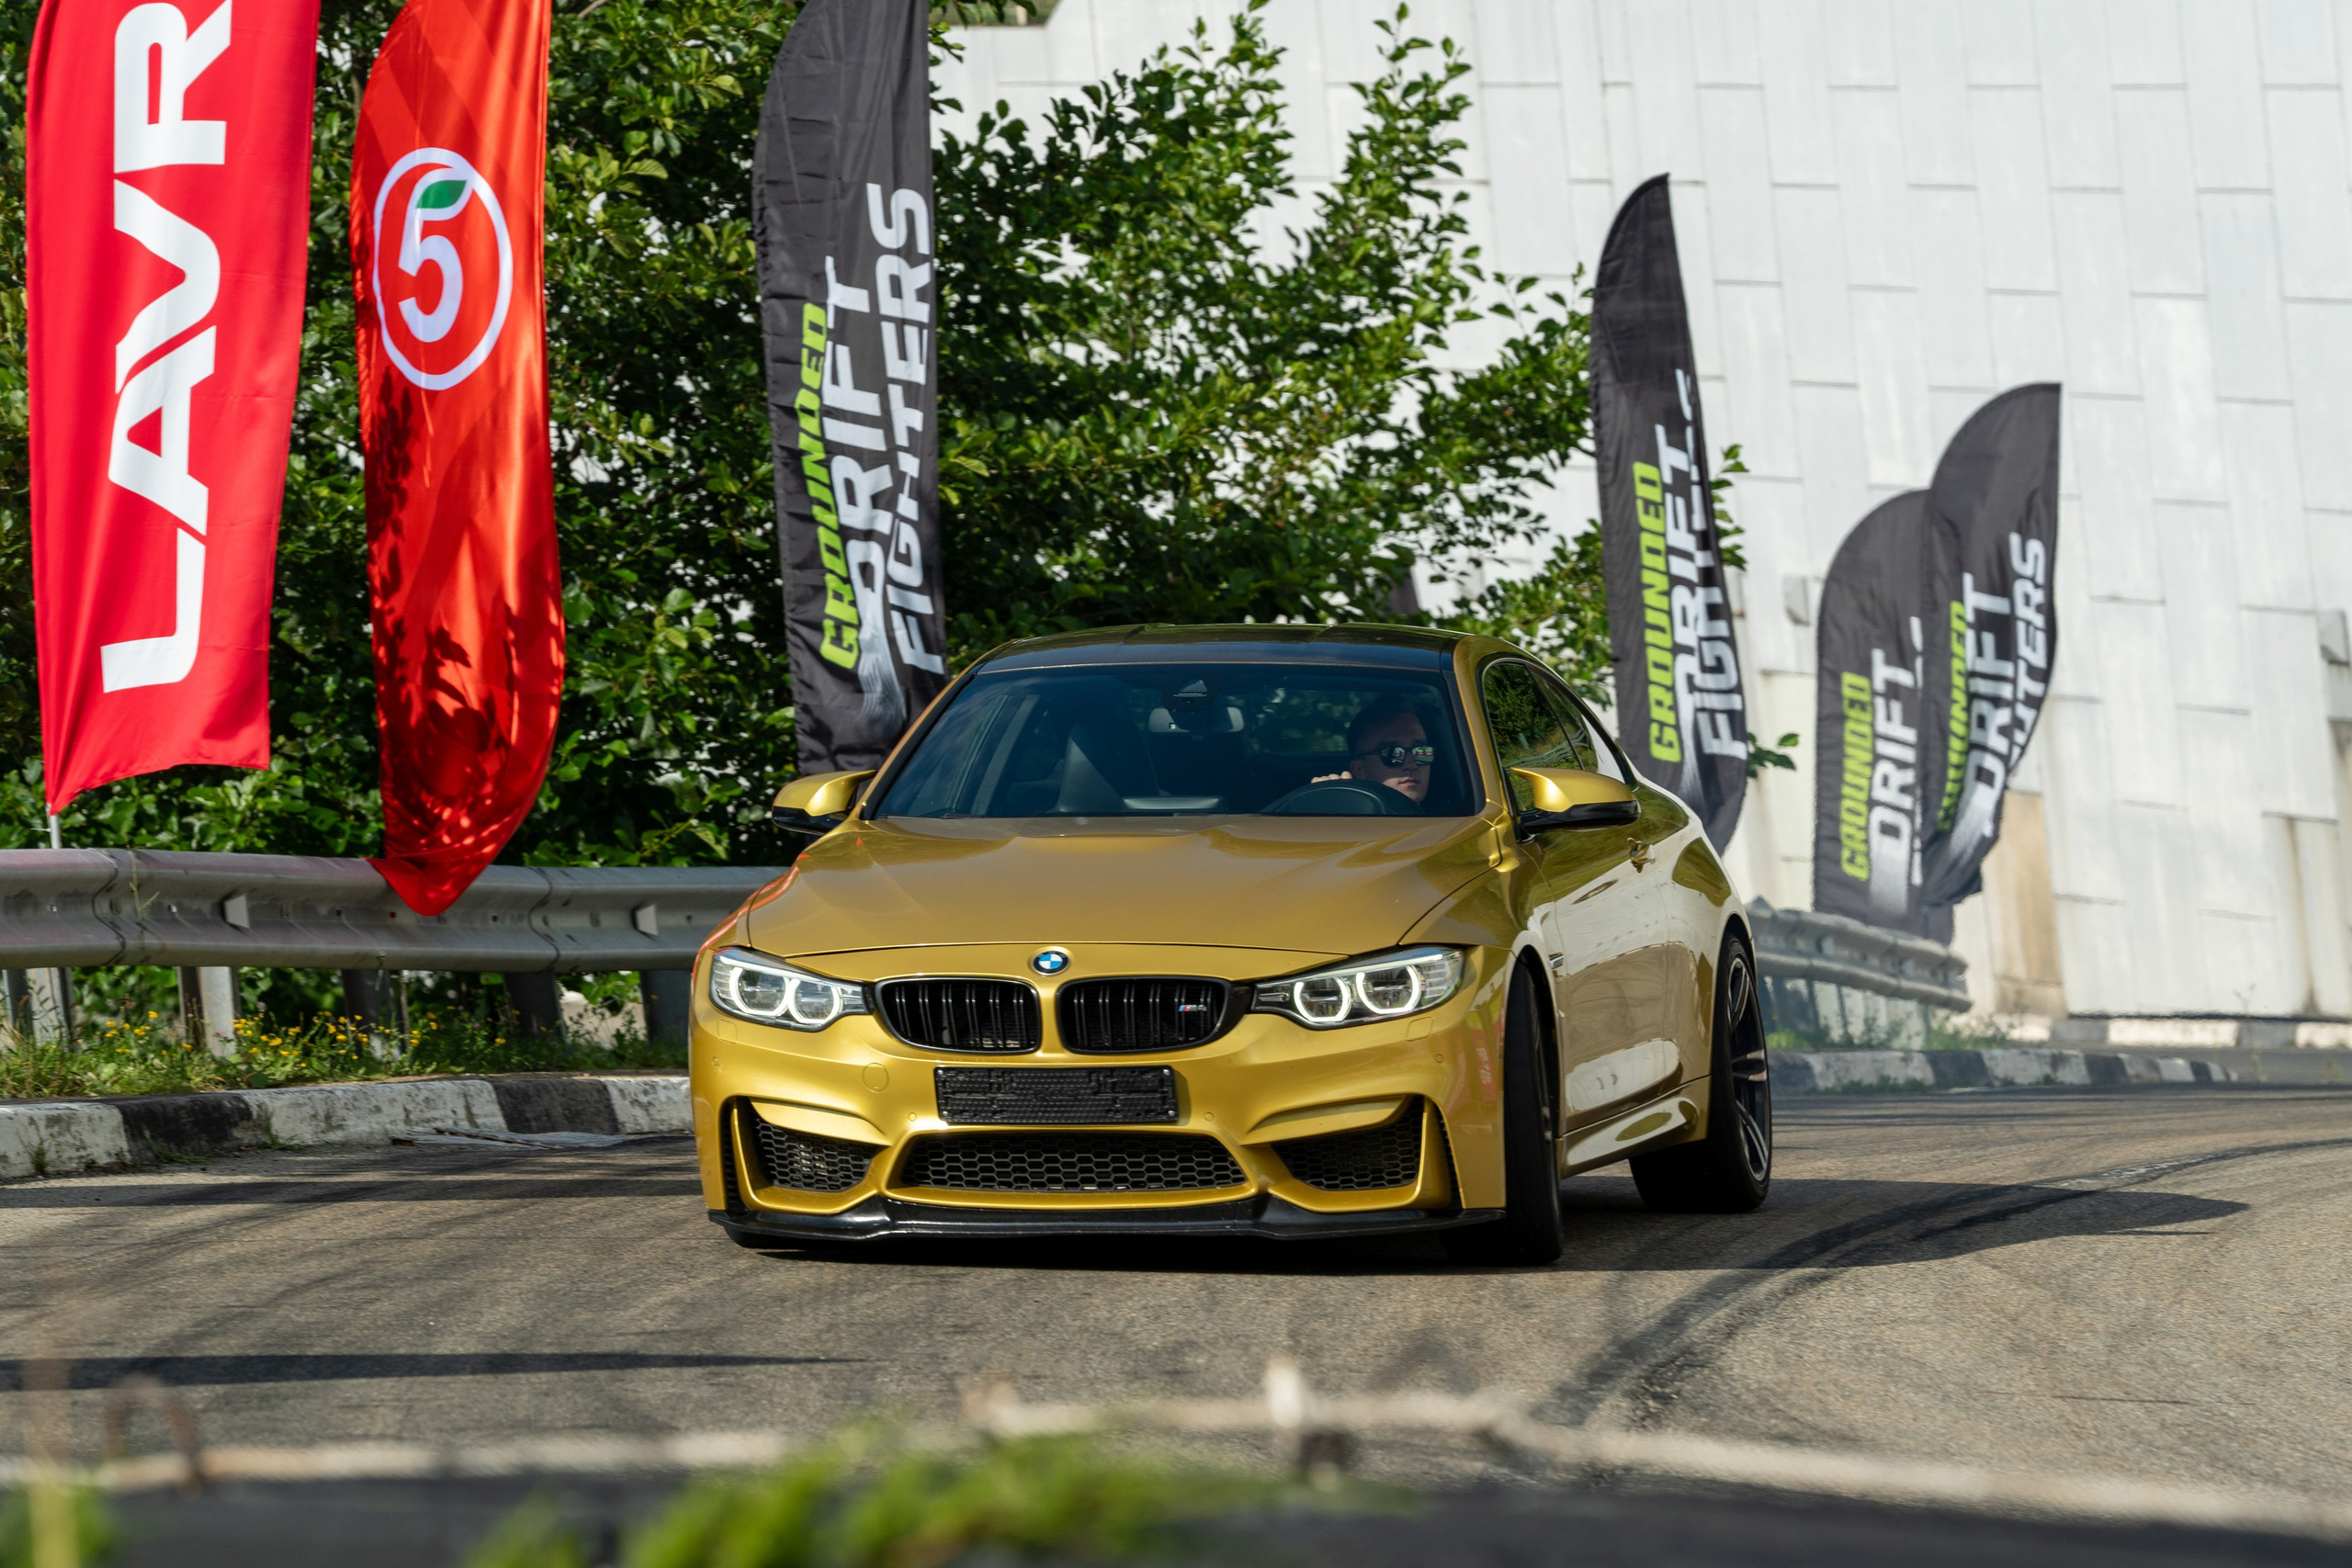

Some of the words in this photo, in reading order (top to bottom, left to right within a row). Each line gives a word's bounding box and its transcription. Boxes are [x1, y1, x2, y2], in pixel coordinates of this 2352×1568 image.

[101, 0, 232, 694] LAVR
[797, 302, 859, 670] GROUNDED
[822, 255, 897, 680] DRIFT
[866, 183, 944, 674] FIGHTERS
[1633, 460, 1682, 762] GROUNDED
[1840, 671, 1874, 883] GROUNDED
[1869, 647, 1918, 877] DRIFT
[1957, 572, 2015, 818] DRIFT
